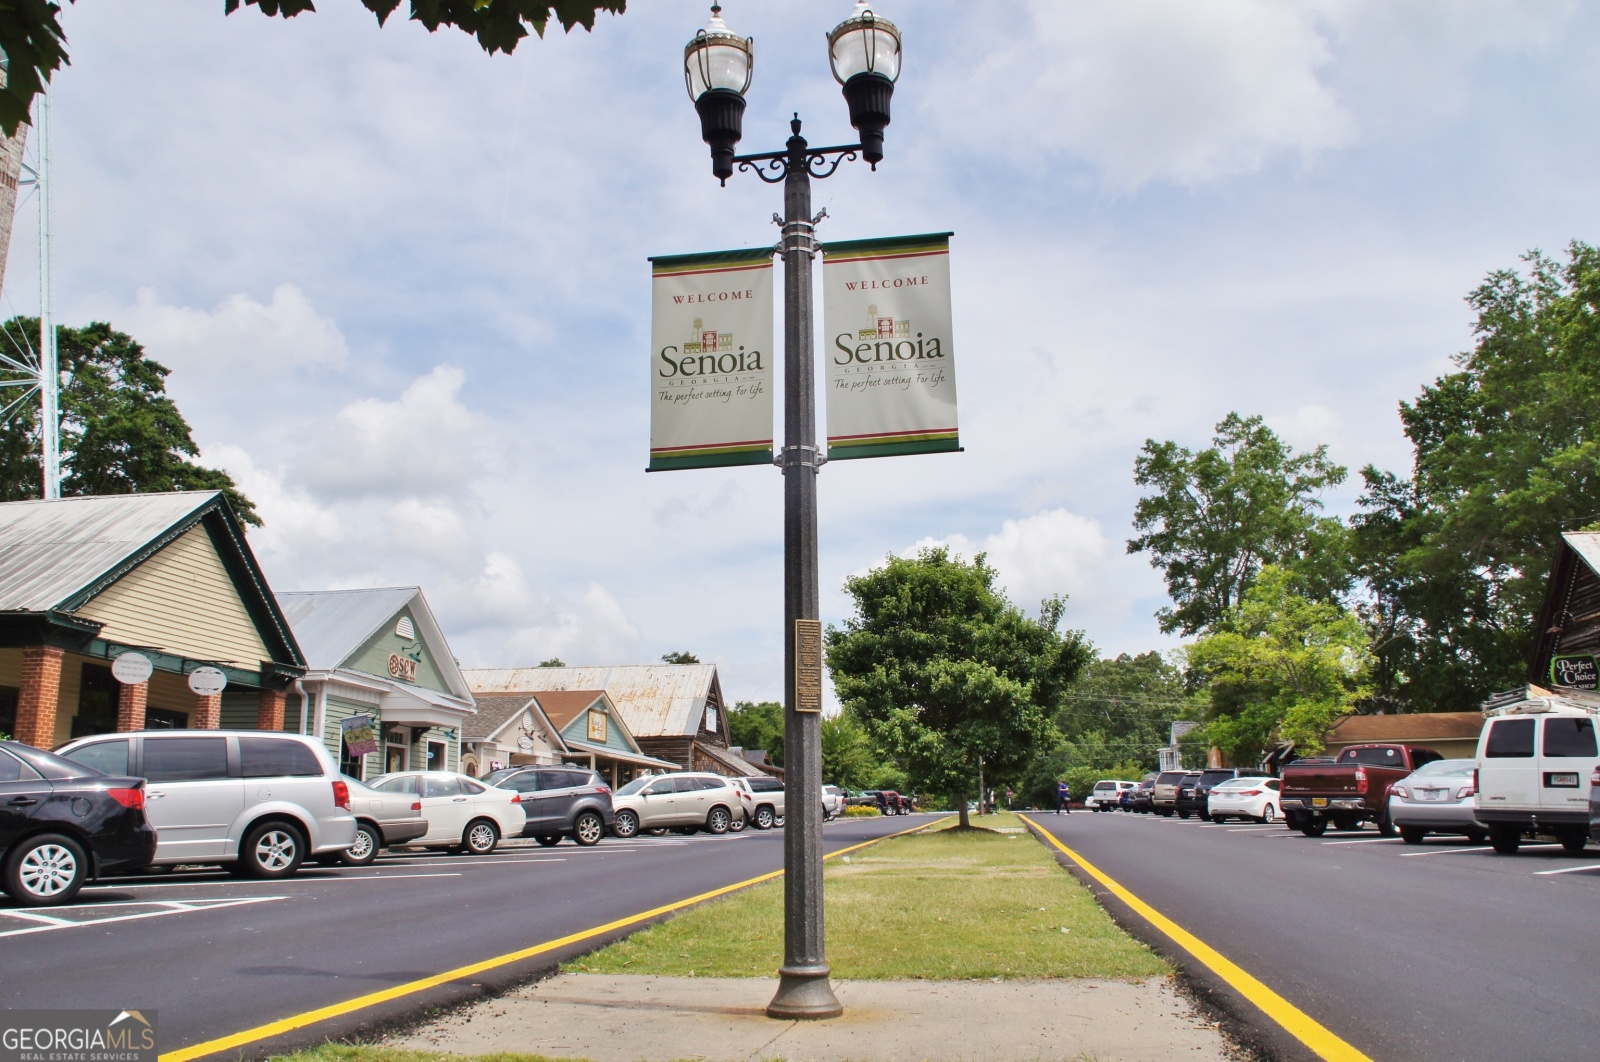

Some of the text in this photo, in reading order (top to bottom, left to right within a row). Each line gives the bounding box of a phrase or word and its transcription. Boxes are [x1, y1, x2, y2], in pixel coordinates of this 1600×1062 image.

[845, 276, 929, 291] WELCOME
[673, 290, 753, 304] WELCOME
[834, 332, 945, 365] Senoia
[659, 345, 764, 377] Senoia
[845, 363, 919, 373] GEORGIA
[669, 376, 739, 386] GEORGIA
[834, 378, 849, 389] The
[850, 374, 881, 392] perfect
[916, 373, 928, 383] For
[931, 370, 947, 387] life.
[659, 391, 673, 401] The
[674, 388, 704, 405] perfect
[736, 385, 747, 395] For
[750, 382, 765, 399] life.
[399, 657, 417, 675] SCW
[1556, 660, 1593, 673] Perfect
[1560, 670, 1596, 684] Choice
